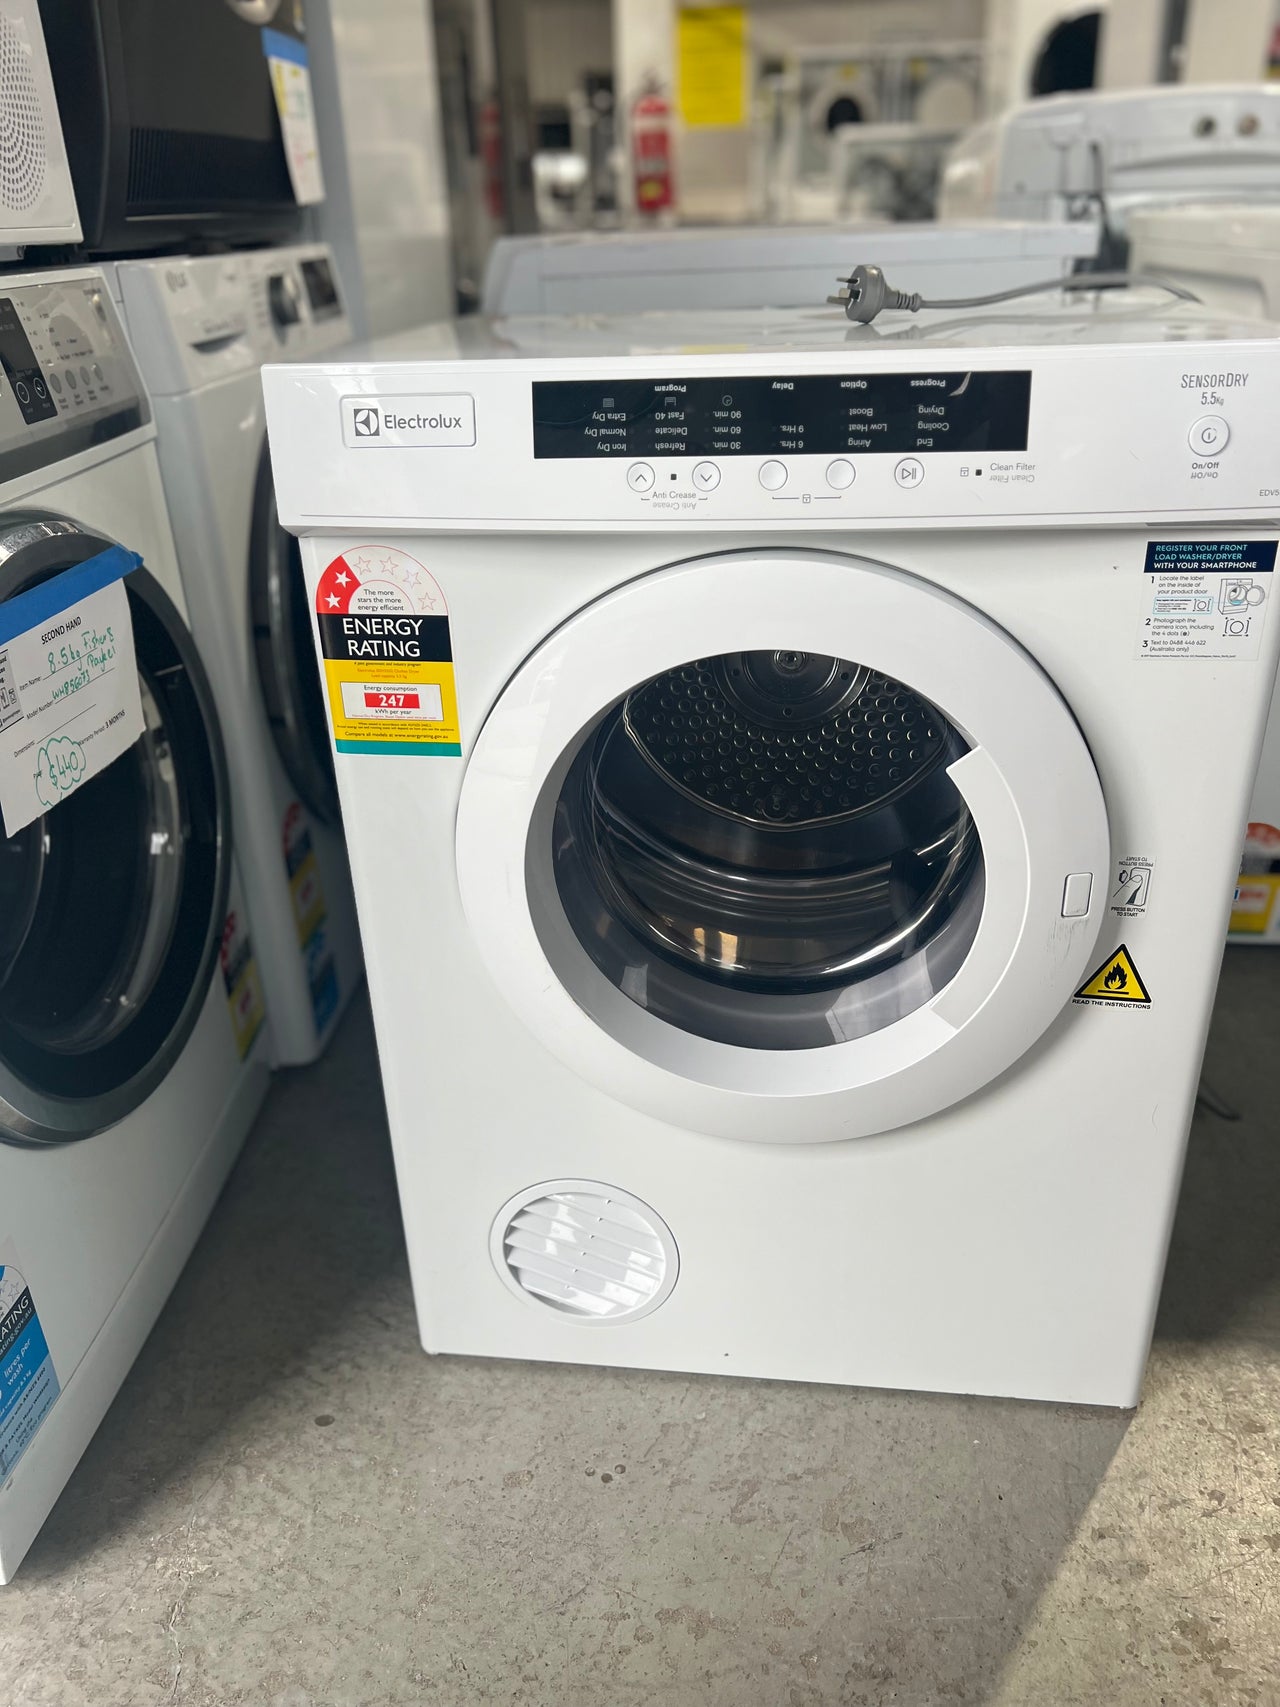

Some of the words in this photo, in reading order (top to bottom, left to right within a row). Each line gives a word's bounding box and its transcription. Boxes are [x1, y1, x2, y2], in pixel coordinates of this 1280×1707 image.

[654, 384, 687, 392] Program
[772, 381, 794, 390] Delay
[841, 380, 867, 389] Option
[911, 379, 945, 388] Progress
[730, 410, 741, 418] 90
[849, 407, 873, 416] Boost
[918, 406, 945, 415] Drying
[592, 412, 606, 422] Dry
[607, 412, 626, 421] Extra
[655, 411, 667, 420] 40
[668, 411, 685, 420] Fast
[384, 413, 462, 429] Electrolux
[655, 426, 688, 435] Delicate
[730, 426, 741, 434] 60
[798, 424, 804, 433] 9
[848, 423, 868, 432] Heat
[870, 423, 888, 431] Low
[917, 421, 949, 431] Cooling
[584, 427, 598, 437] Dry
[599, 427, 626, 436] Normal
[612, 442, 627, 451] Iron
[655, 442, 686, 450] Refresh
[730, 441, 741, 449] 30
[797, 440, 803, 448] 6
[848, 437, 871, 447] Airing
[917, 437, 933, 447] End
[597, 442, 610, 452] Dry
[990, 463, 1014, 471] Clean
[1016, 462, 1035, 471] Filter
[1191, 462, 1220, 470] On/Off
[989, 475, 1009, 483] Filter
[1011, 474, 1035, 482] Clean
[652, 491, 667, 499] Anti
[668, 491, 696, 499] Crease
[652, 502, 680, 510] Crease
[681, 502, 697, 510] Anti
[1156, 544, 1193, 552] REGISTER
[1195, 544, 1218, 552] YOUR
[1179, 553, 1243, 561] WASHER/DRYER
[1200, 561, 1257, 569] SMARTPHONE
[1151, 576, 1155, 584] 1
[41, 625, 65, 645] SECOND
[65, 616, 82, 632] HAND
[342, 618, 423, 636] ENERGY
[347, 640, 421, 657] RATING
[1142, 640, 1149, 648] 3
[378, 694, 405, 707] 247
[49, 751, 79, 789] $440
[1105, 1001, 1151, 1010] INSTRUCTIONS
[0, 1295, 29, 1343] ATING
[3, 1354, 21, 1378] litres
[20, 1338, 31, 1358] per
[7, 1363, 24, 1386] wash
